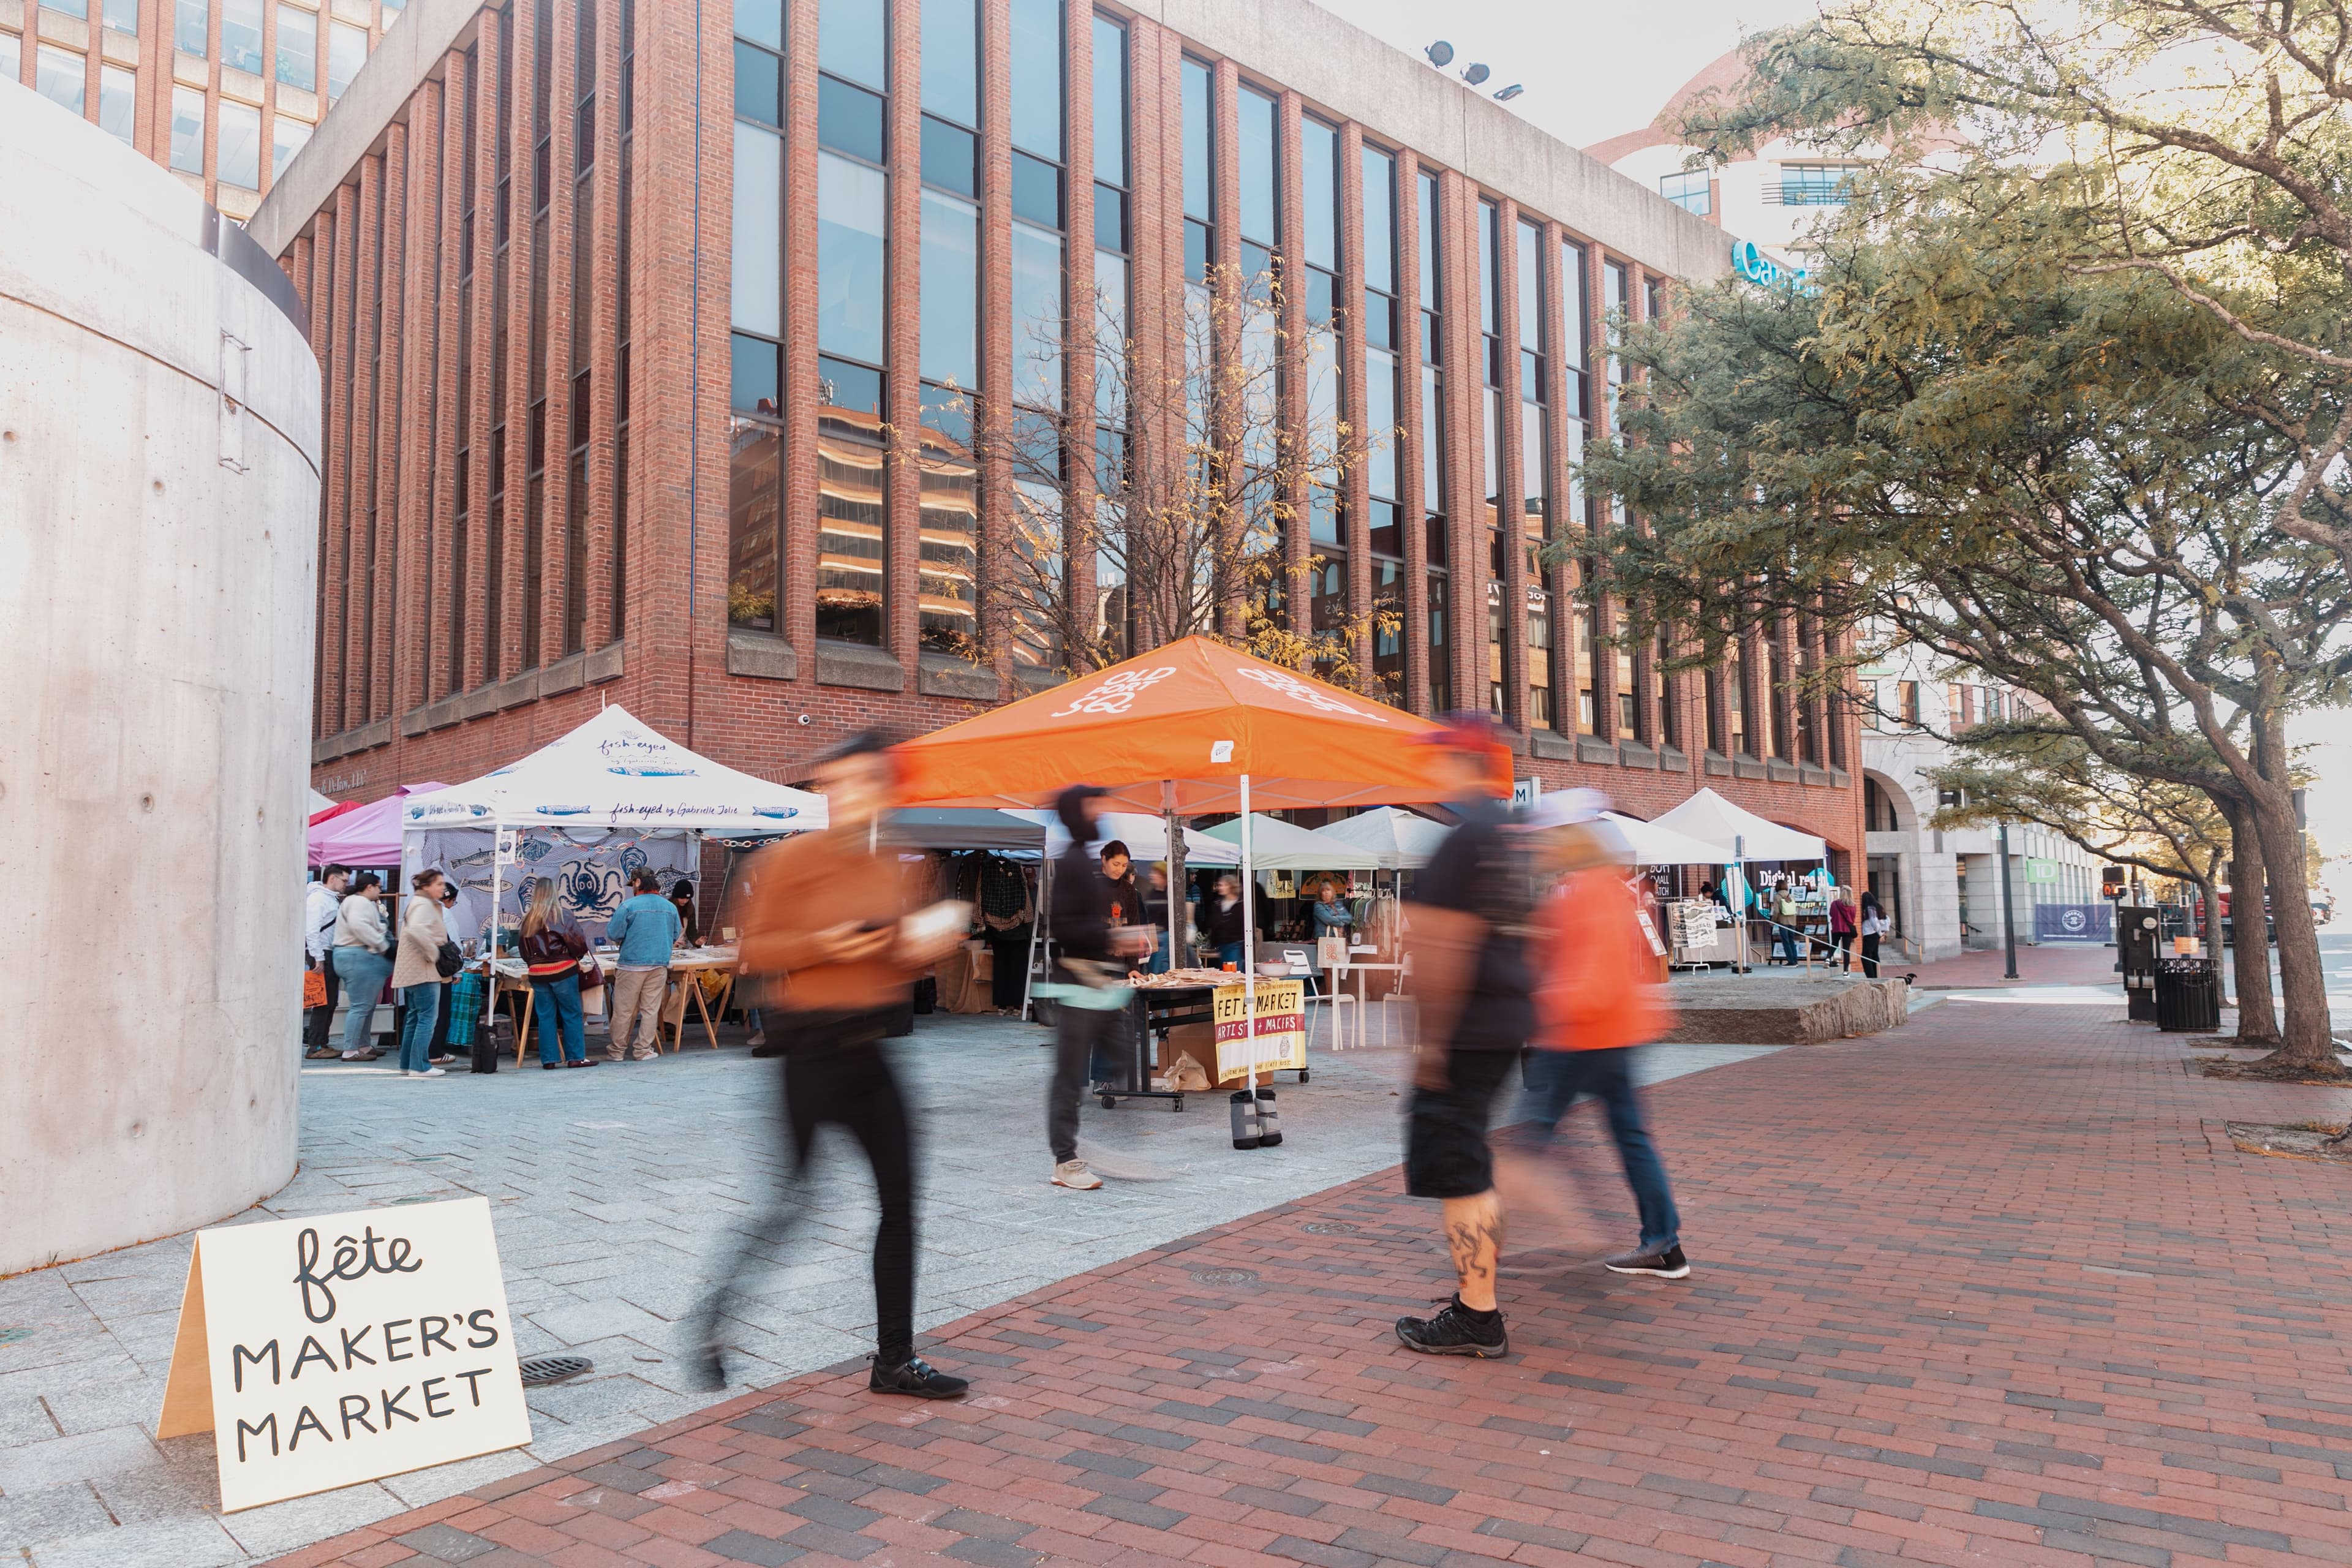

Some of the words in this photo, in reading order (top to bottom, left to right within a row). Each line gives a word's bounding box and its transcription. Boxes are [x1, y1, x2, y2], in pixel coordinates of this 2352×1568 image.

[1104, 666, 1177, 685] OLD
[1085, 680, 1159, 697] PORT
[1050, 692, 1135, 717] SQ.
[597, 739, 666, 756] fish-eyed
[609, 803, 663, 823] fish-eyed
[665, 807, 675, 816] by
[677, 802, 714, 817] Gabrielle
[717, 805, 738, 815] Jolie
[2033, 864, 2055, 878] TD
[1256, 992, 1297, 1012] MARKET
[292, 1226, 423, 1324] fête
[232, 1309, 499, 1393] MAKER'S
[236, 1368, 493, 1463] MARKET
